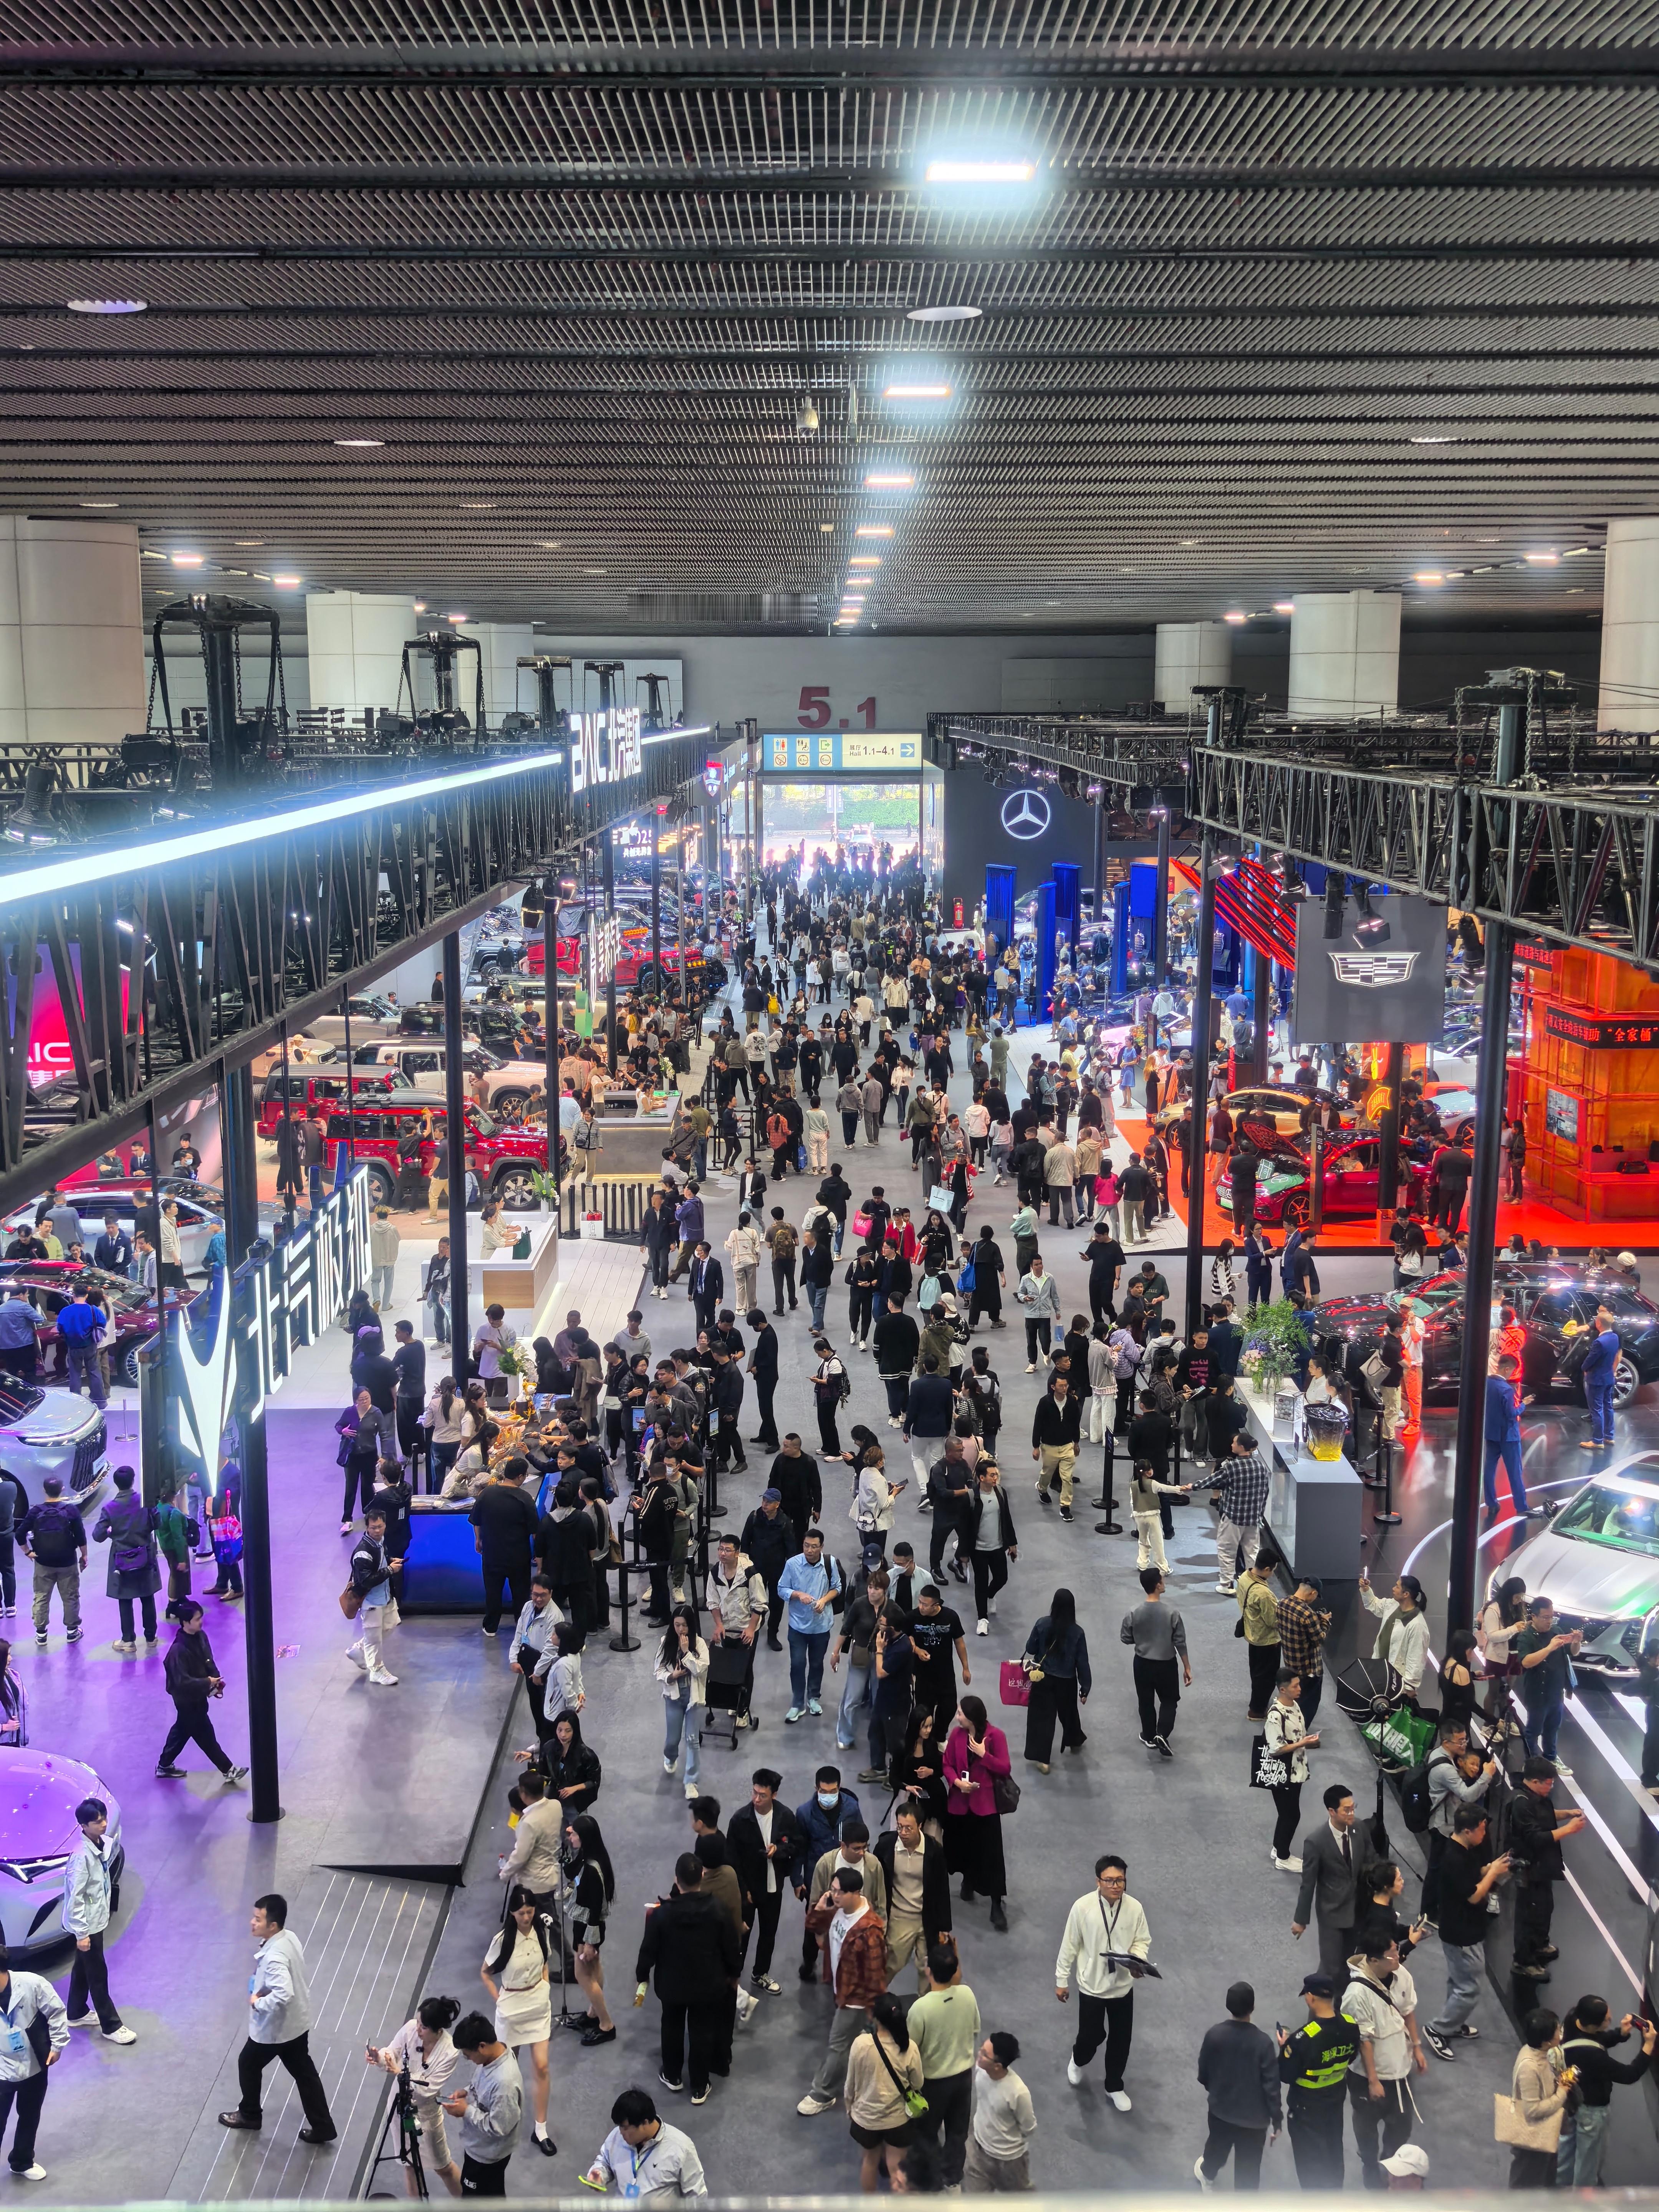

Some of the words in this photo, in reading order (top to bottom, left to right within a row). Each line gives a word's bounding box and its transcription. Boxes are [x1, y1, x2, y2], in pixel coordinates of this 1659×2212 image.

[797, 686, 876, 729] 5.1
[608, 708, 641, 783] 北汽集团
[598, 910, 622, 983] 享界汽车
[28, 1042, 71, 1063] IC
[248, 1164, 373, 1424] 北汽极狐
